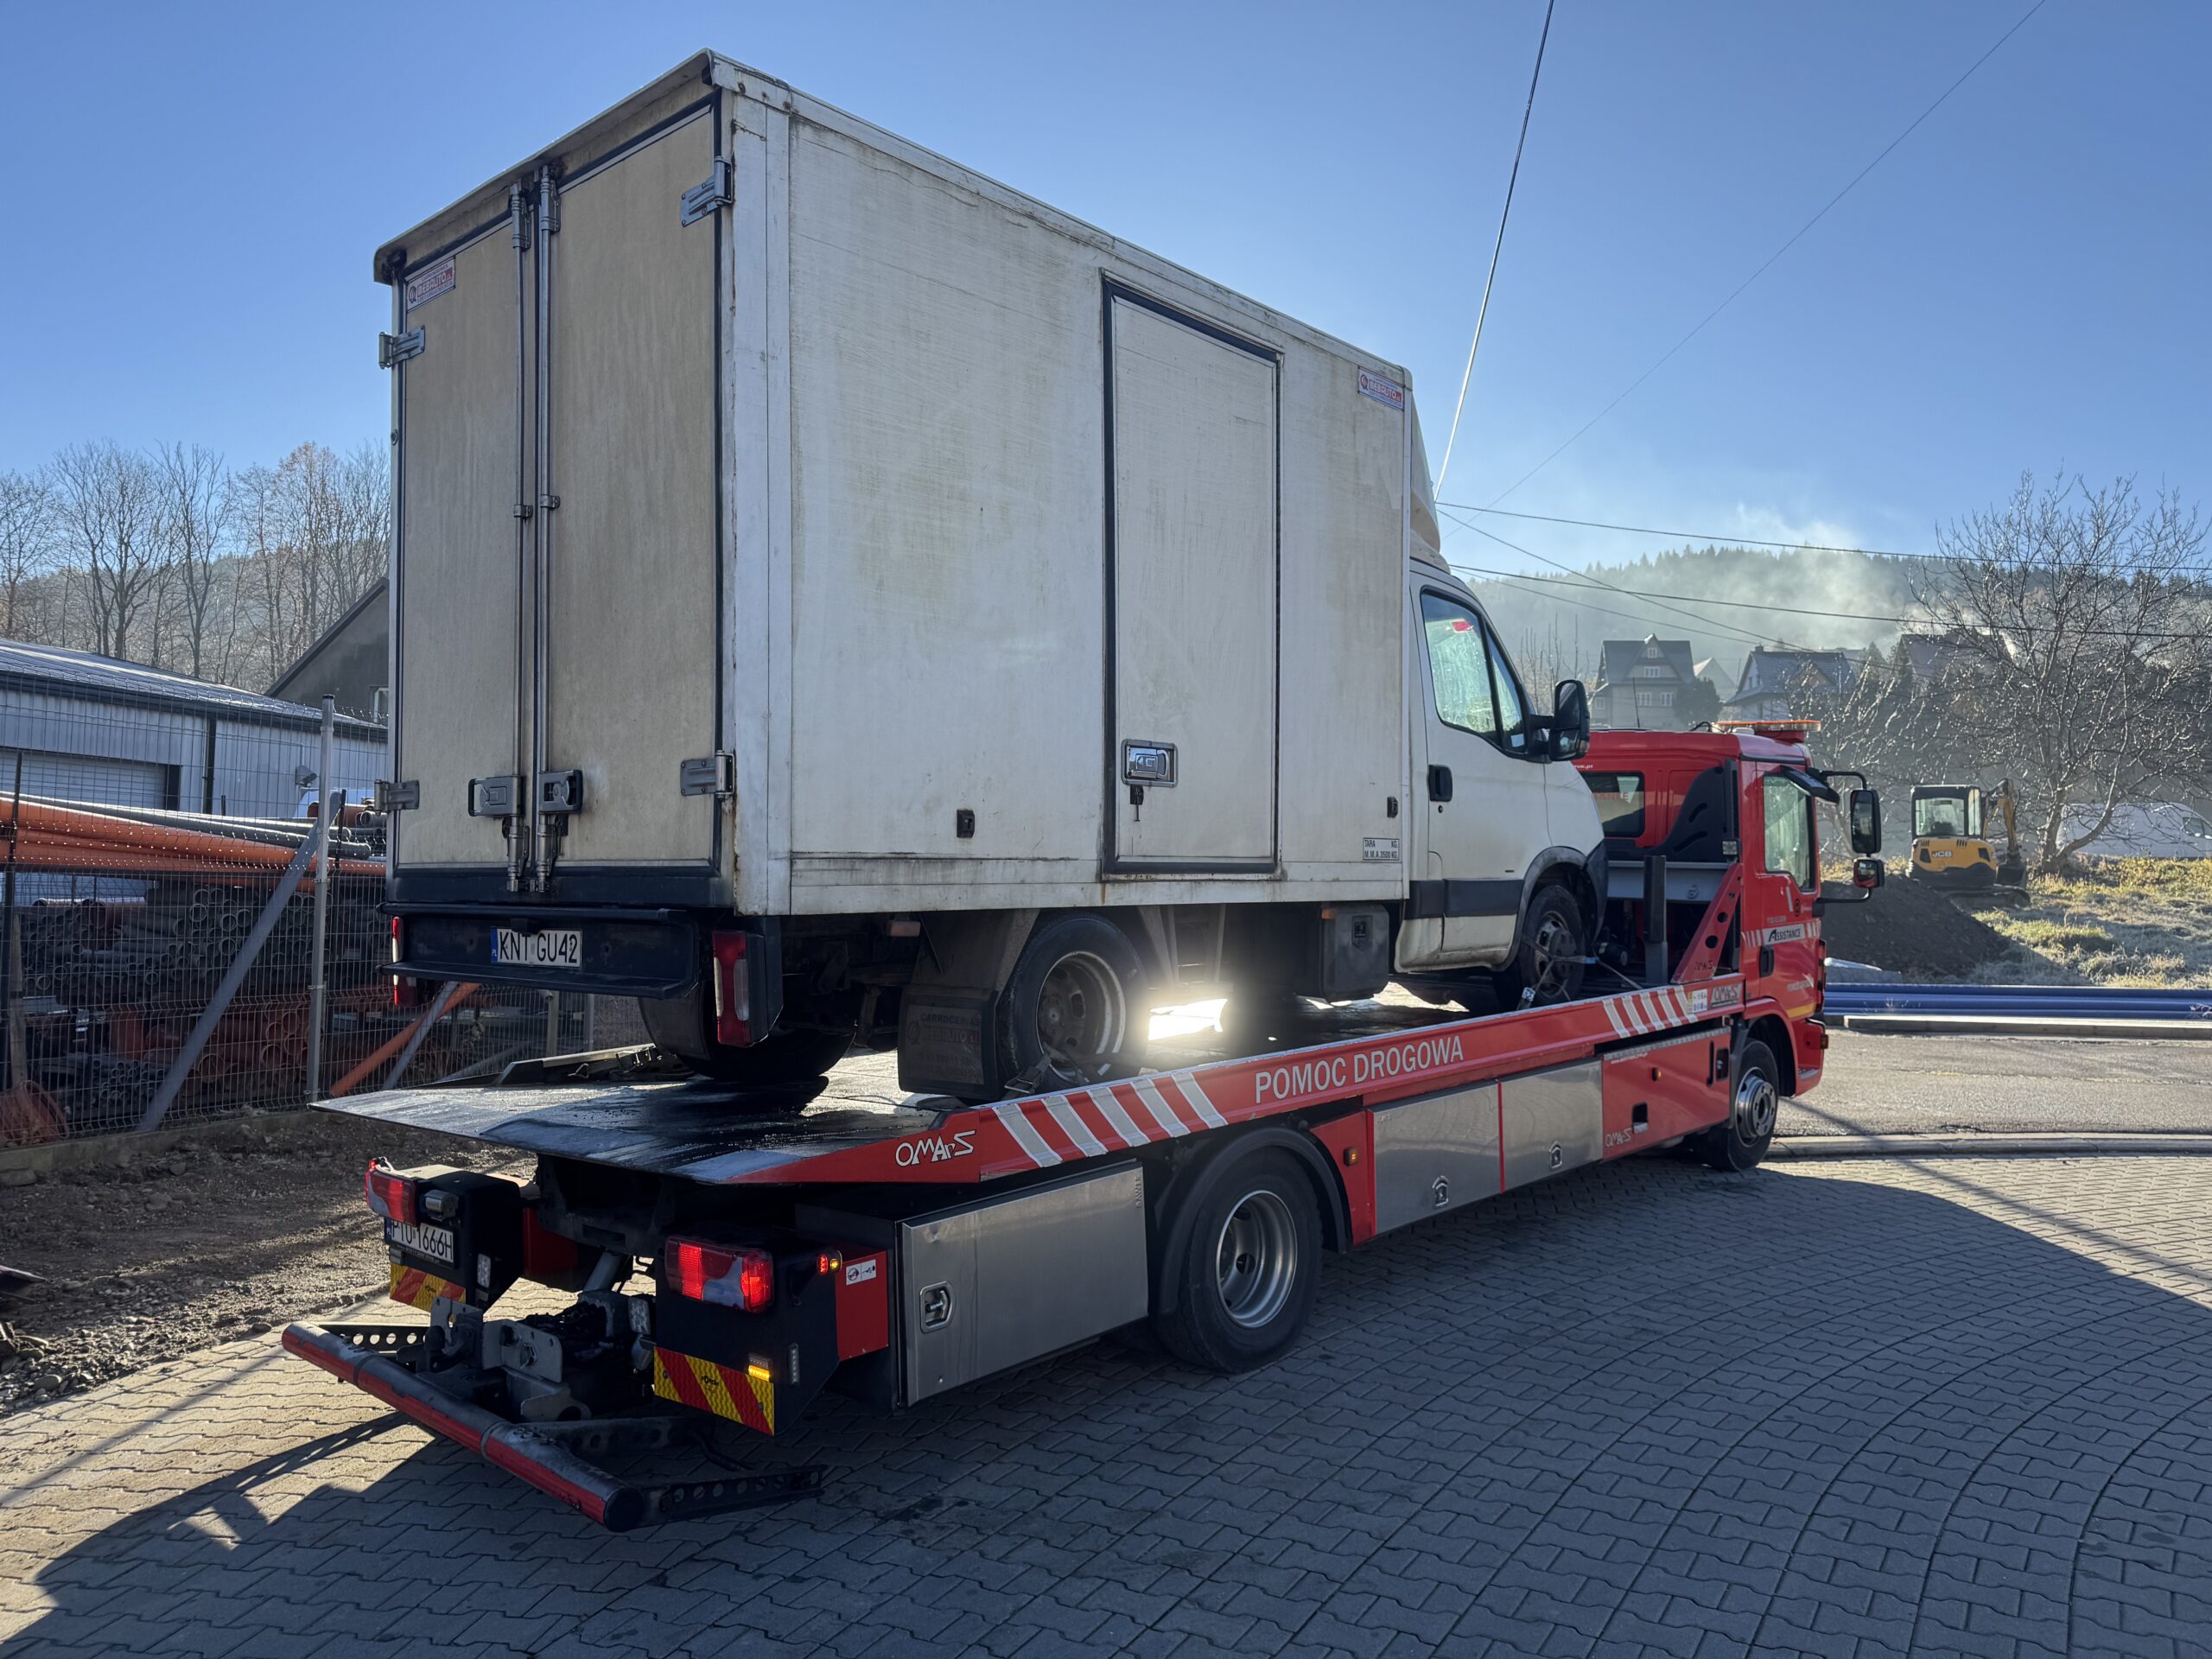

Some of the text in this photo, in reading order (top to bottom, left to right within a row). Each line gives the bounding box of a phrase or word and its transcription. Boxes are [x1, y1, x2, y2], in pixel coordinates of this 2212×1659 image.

[499, 931, 578, 963] KNT GU42
[1769, 929, 1801, 942] ASSISTANCE
[1255, 1035, 1464, 1103] POMOC DROGOWA
[416, 1225, 453, 1260] 1666H
